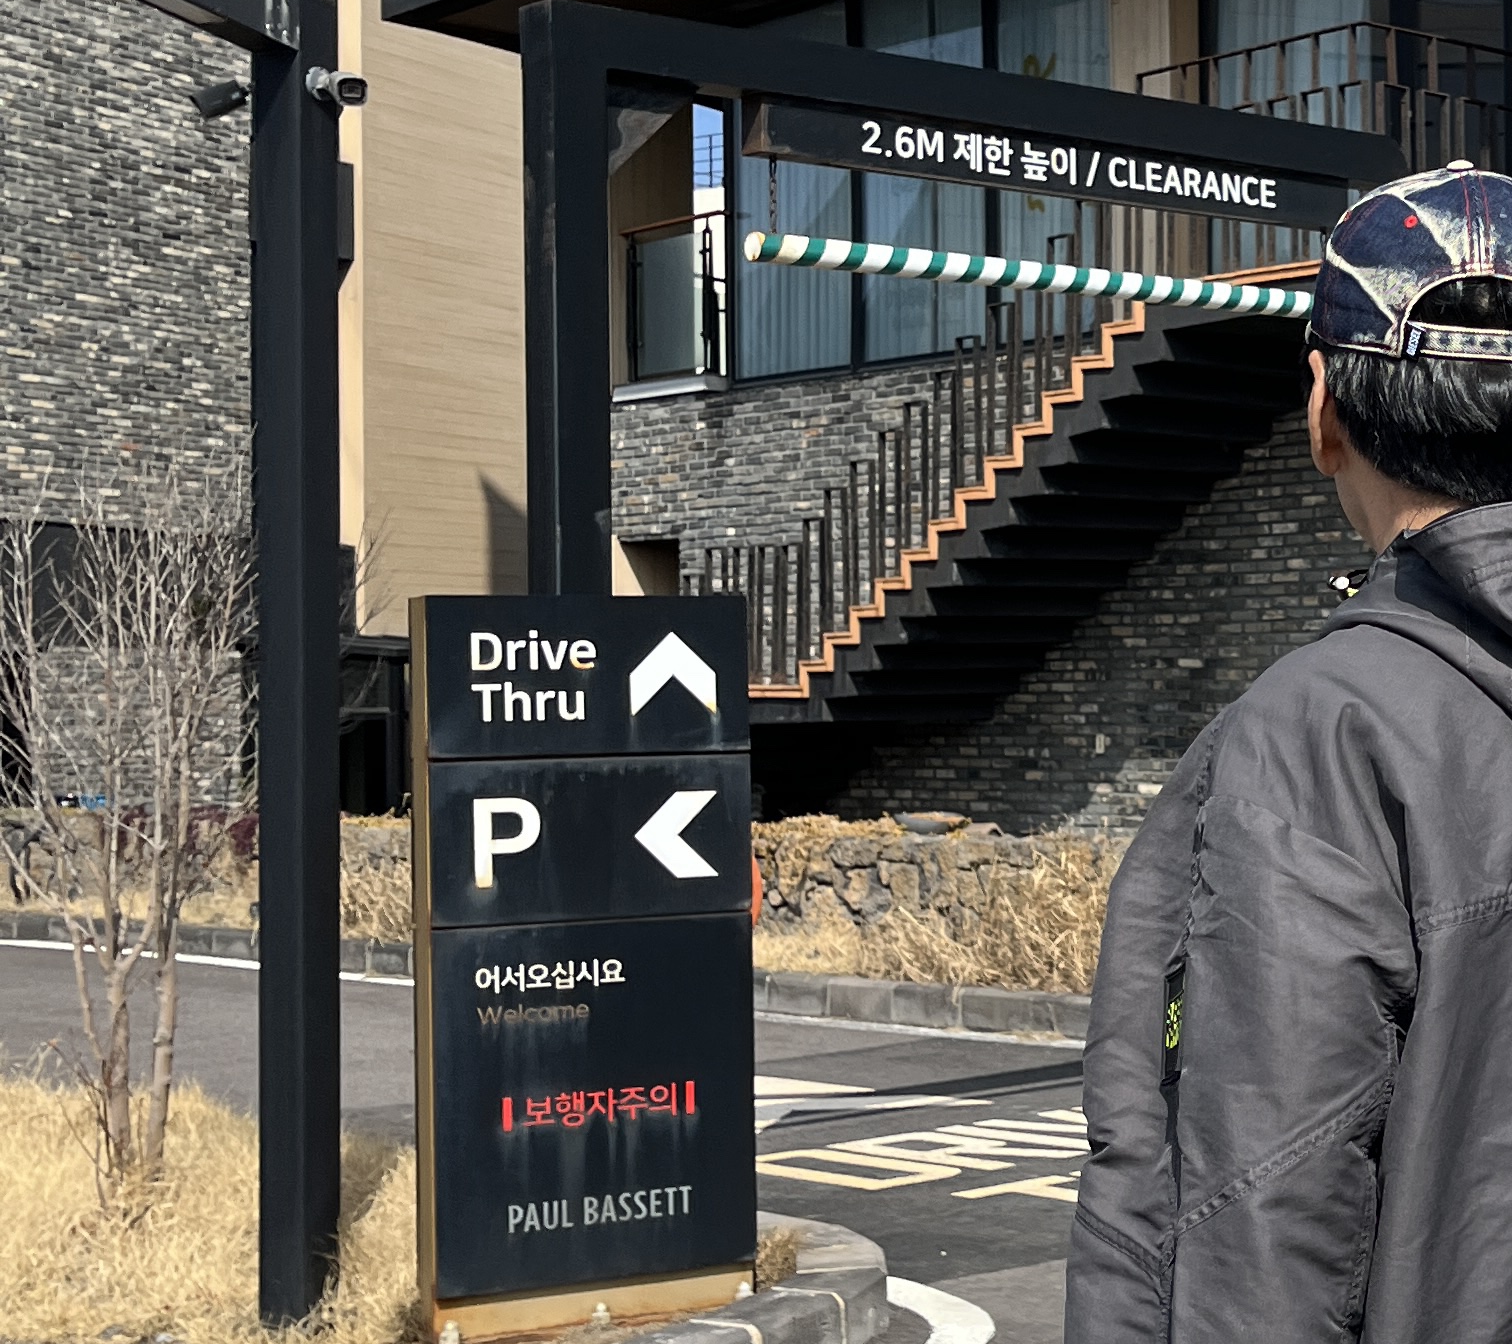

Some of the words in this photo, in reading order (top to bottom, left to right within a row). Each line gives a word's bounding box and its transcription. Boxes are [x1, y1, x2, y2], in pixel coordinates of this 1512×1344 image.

[861, 121, 944, 163] 2.6M
[953, 133, 1014, 177] 제한
[1019, 141, 1078, 186] 높이
[1108, 156, 1277, 209] CLEARANCE
[470, 629, 597, 670] Drive
[471, 681, 585, 722] Thru
[472, 797, 542, 889] P
[475, 958, 626, 994] 어서오십시요
[477, 1002, 590, 1025] Welcome
[522, 1082, 678, 1128] 보행자주의
[508, 1199, 574, 1234] PAUL
[583, 1185, 692, 1225] BASSETT
